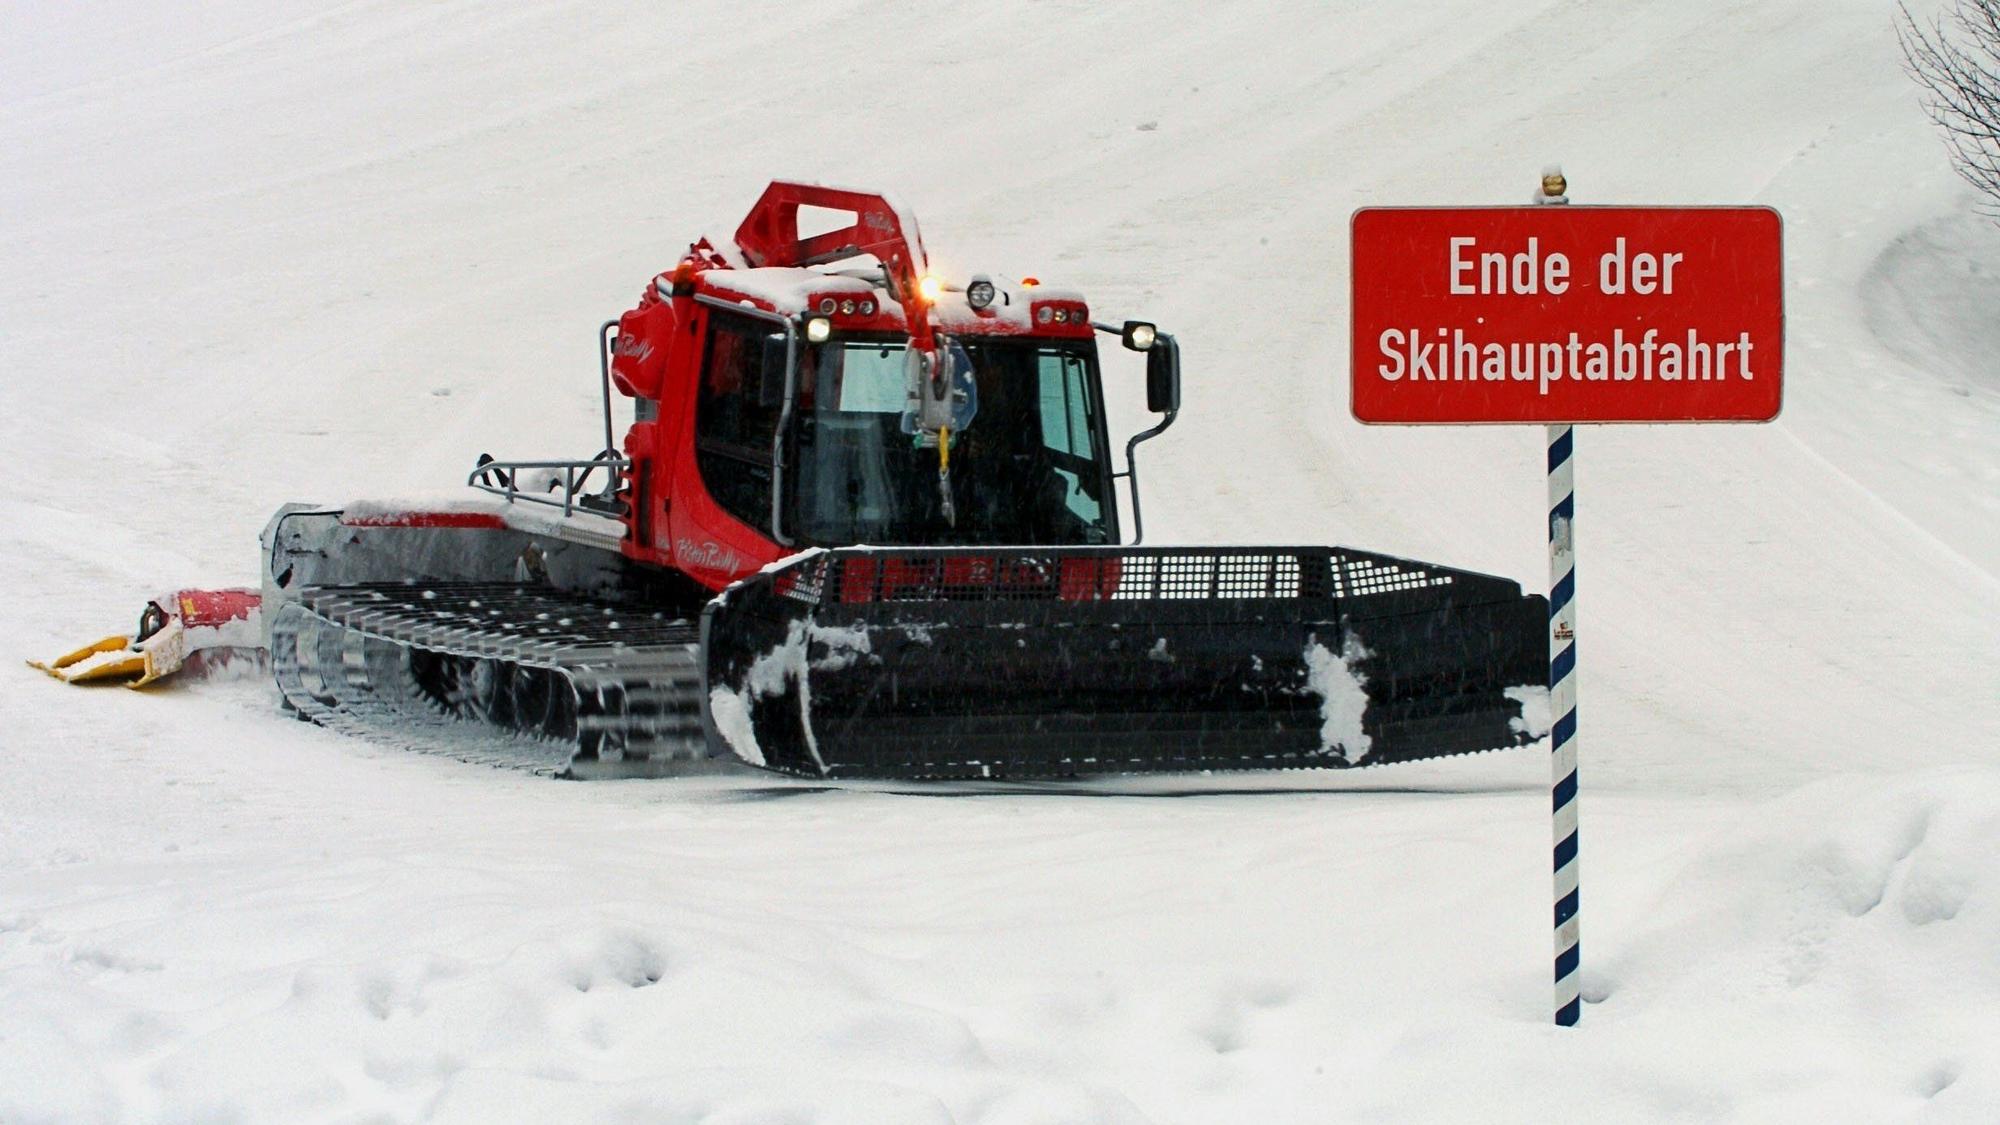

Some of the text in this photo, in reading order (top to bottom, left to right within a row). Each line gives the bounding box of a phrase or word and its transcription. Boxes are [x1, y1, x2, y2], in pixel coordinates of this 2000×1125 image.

[1450, 236, 1683, 295] Ende der
[1378, 327, 1754, 395] Skihauptabfahrt
